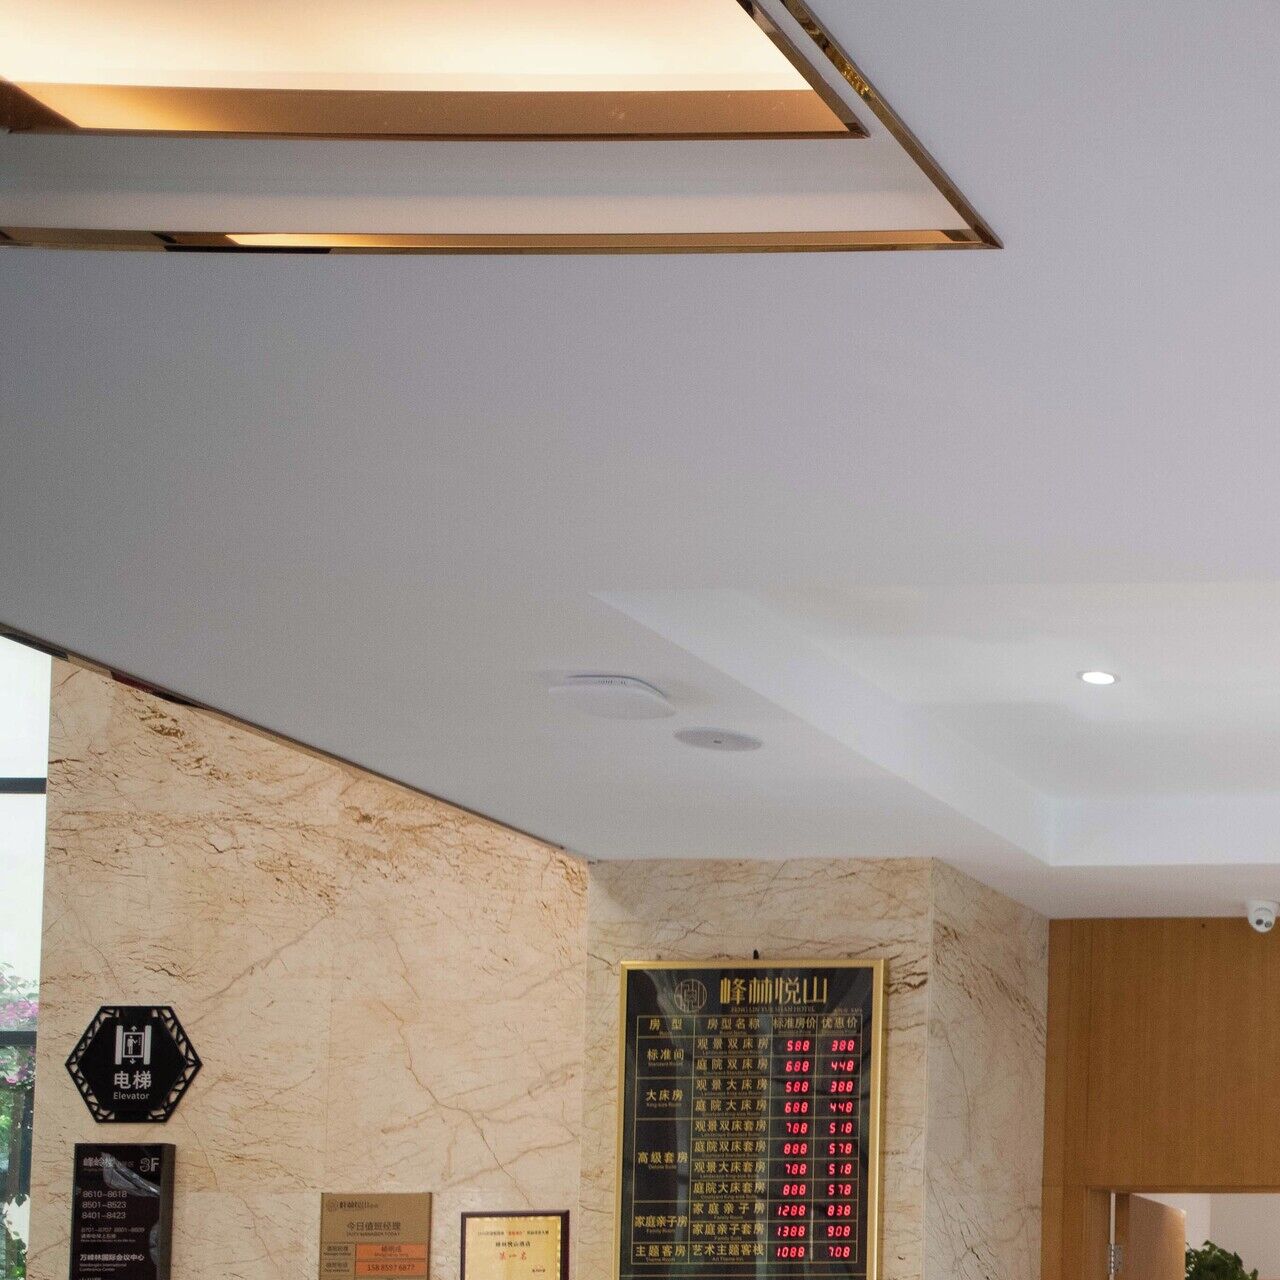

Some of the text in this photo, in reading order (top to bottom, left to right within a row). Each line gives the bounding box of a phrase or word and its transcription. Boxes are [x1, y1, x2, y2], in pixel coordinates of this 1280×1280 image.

[720, 976, 828, 1005] 峰林悦山
[772, 1017, 816, 1030] 标准房价
[822, 1016, 858, 1029] 优惠价
[787, 1039, 810, 1052] 588
[832, 1039, 855, 1052] 388
[647, 1048, 684, 1061] 标准间
[785, 1061, 809, 1072] 688
[831, 1061, 854, 1072] 448
[114, 1070, 152, 1089] 电梯
[785, 1081, 808, 1093] 588
[830, 1081, 853, 1093] 388
[113, 1091, 150, 1100] Elevator
[646, 1089, 683, 1101] 大床房
[784, 1102, 808, 1113] 688
[829, 1102, 853, 1113] 448
[786, 1122, 808, 1134] 788
[829, 1122, 853, 1134] 518
[784, 1143, 808, 1155] 888
[828, 1143, 852, 1155] 578
[637, 1151, 688, 1164] 高级套房
[140, 1157, 160, 1172] 3F
[785, 1163, 807, 1175] 788
[828, 1163, 852, 1175] 518
[783, 1184, 806, 1196] 888
[828, 1184, 852, 1196] 578
[777, 1204, 806, 1216] 1288
[827, 1204, 851, 1217] 838
[776, 1225, 805, 1237] 1388
[827, 1225, 851, 1237] 908
[635, 1245, 687, 1257] 主题客房
[776, 1246, 805, 1258] 1088
[828, 1246, 851, 1258] 708
